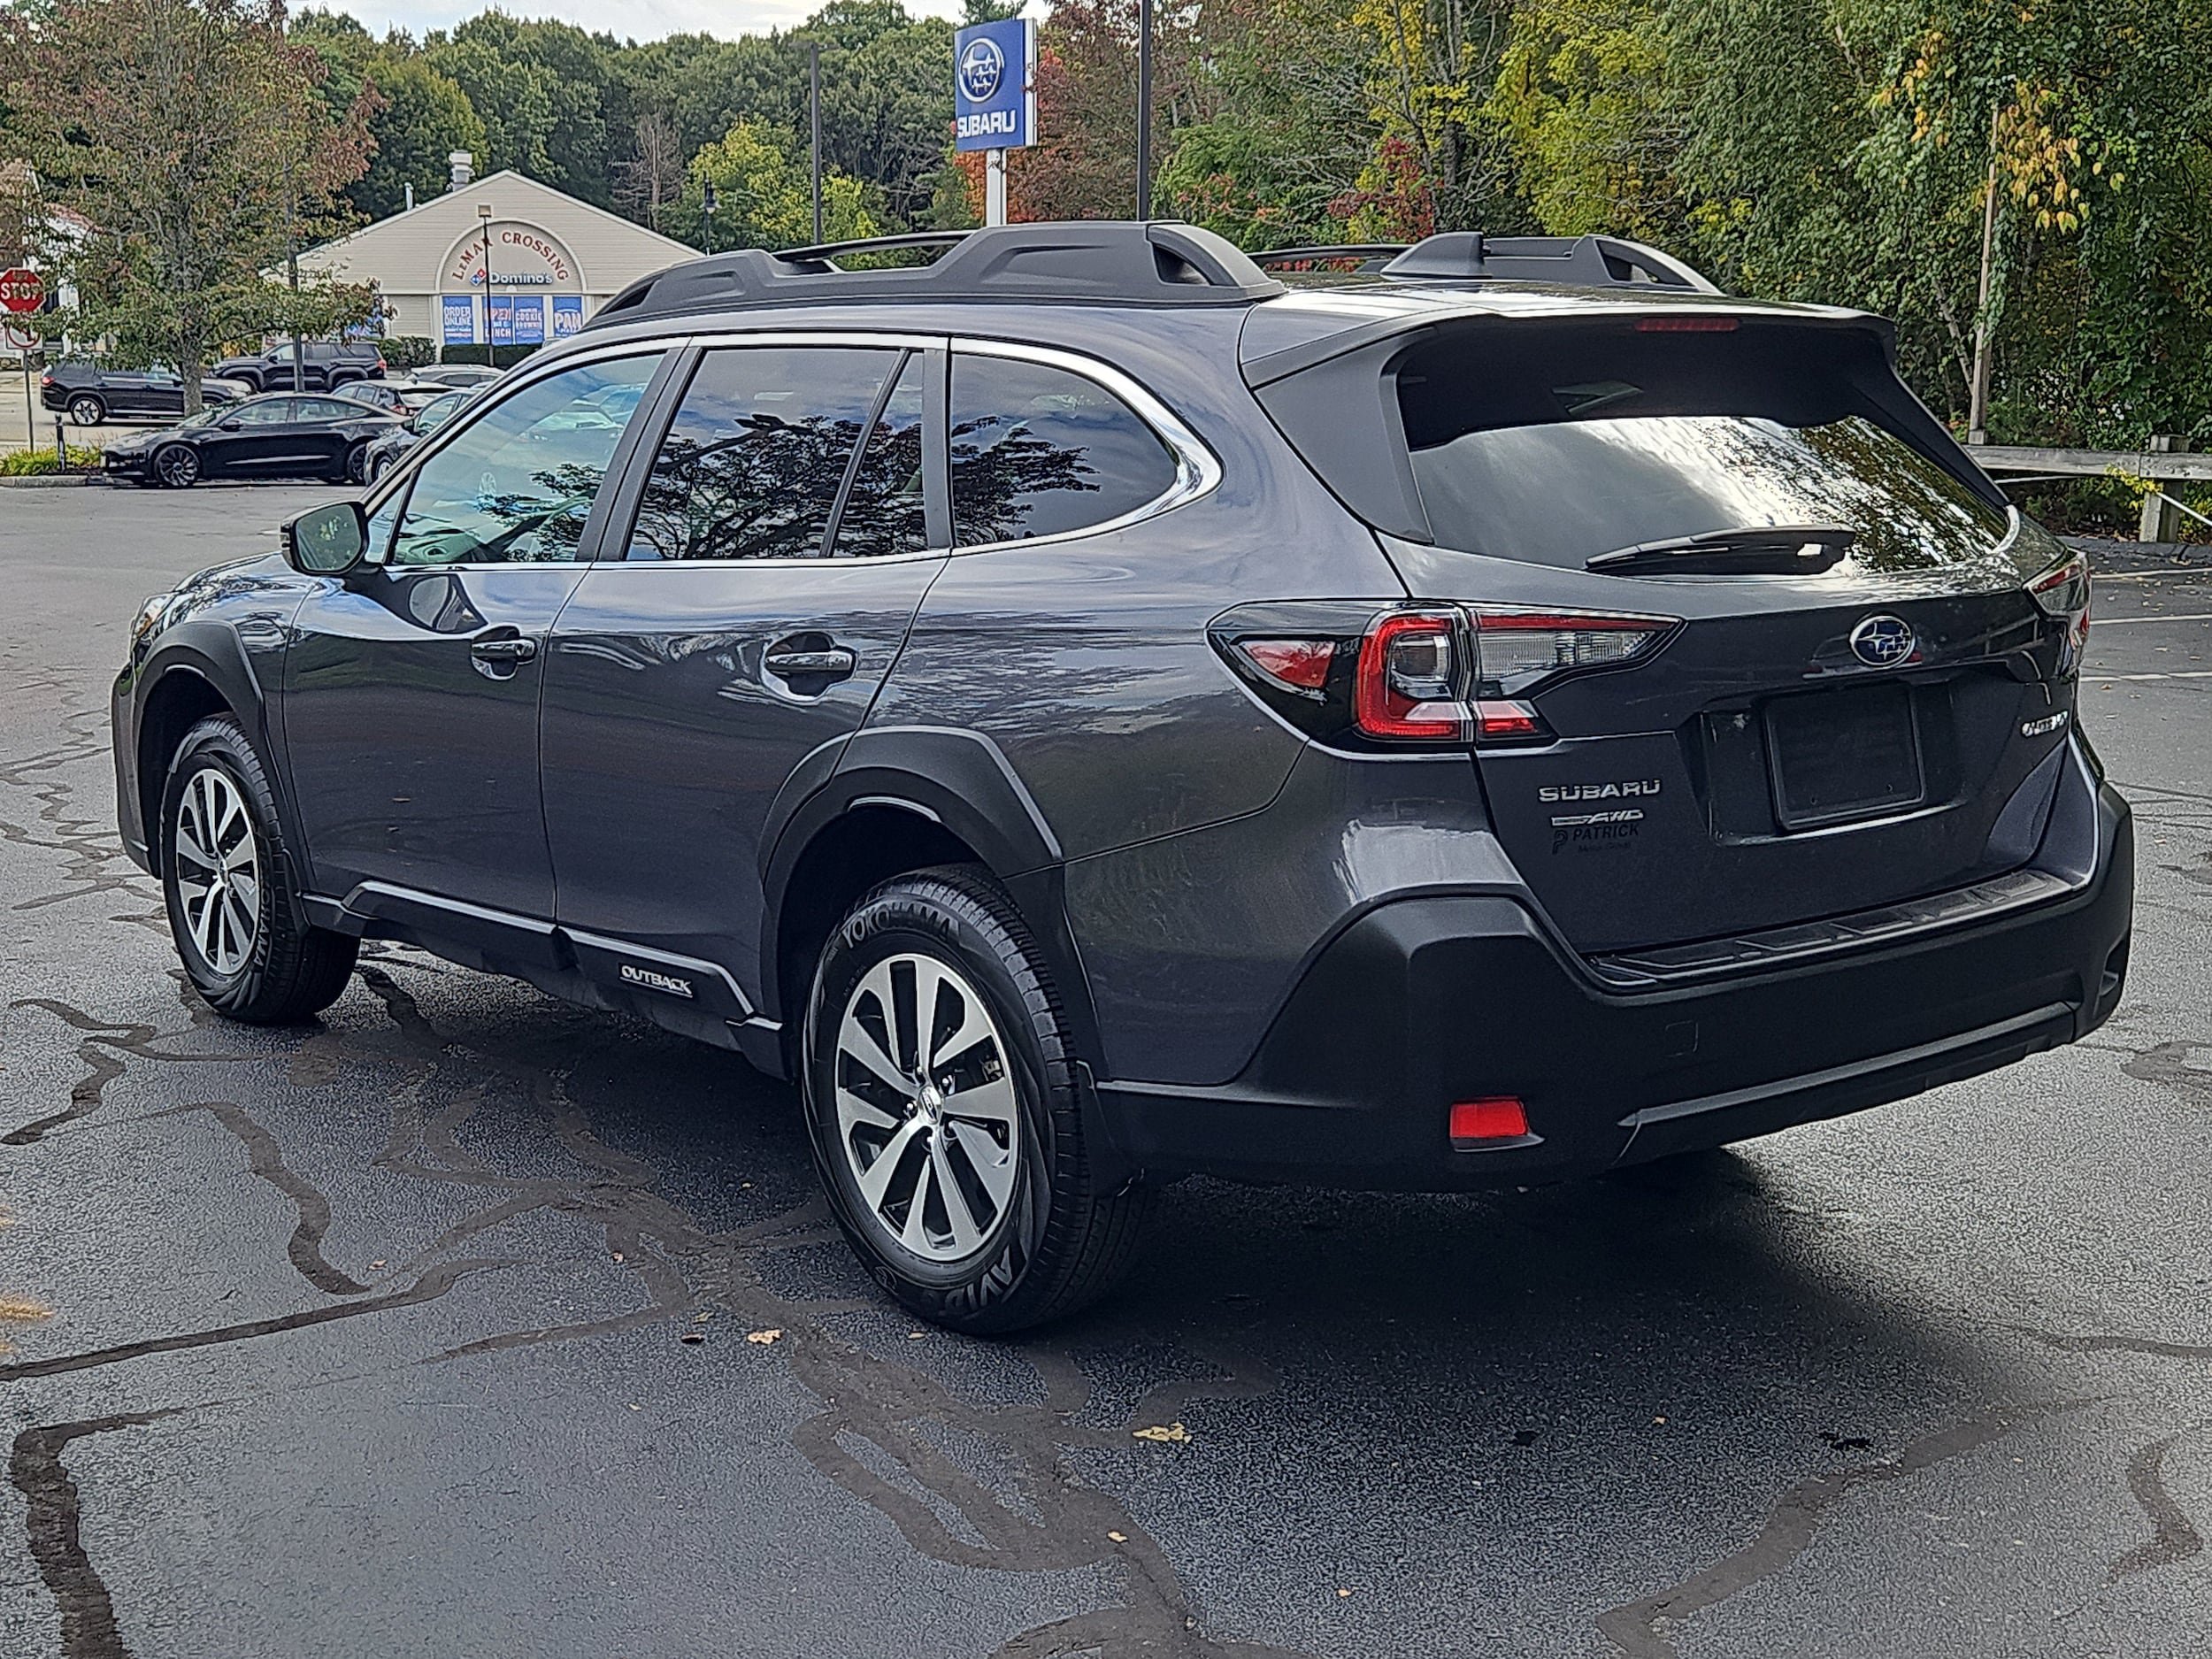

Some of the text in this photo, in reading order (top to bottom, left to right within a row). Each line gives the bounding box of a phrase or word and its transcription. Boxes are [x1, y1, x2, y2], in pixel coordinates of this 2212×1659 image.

[957, 110, 1016, 138] SUBARU
[502, 232, 569, 280] CROSSING
[489, 272, 553, 284] Domino's
[1, 282, 41, 300] STOP
[443, 306, 471, 318] ORDER
[516, 312, 542, 321] COOKIE
[444, 317, 472, 326] ONLINE
[554, 312, 581, 331] PAN
[1539, 780, 1661, 802] SUBARU
[1586, 810, 1644, 825] AWD
[1572, 823, 1640, 841] PATRICK
[841, 901, 960, 949] YOKOHAMA
[621, 965, 692, 995] OUTBACK
